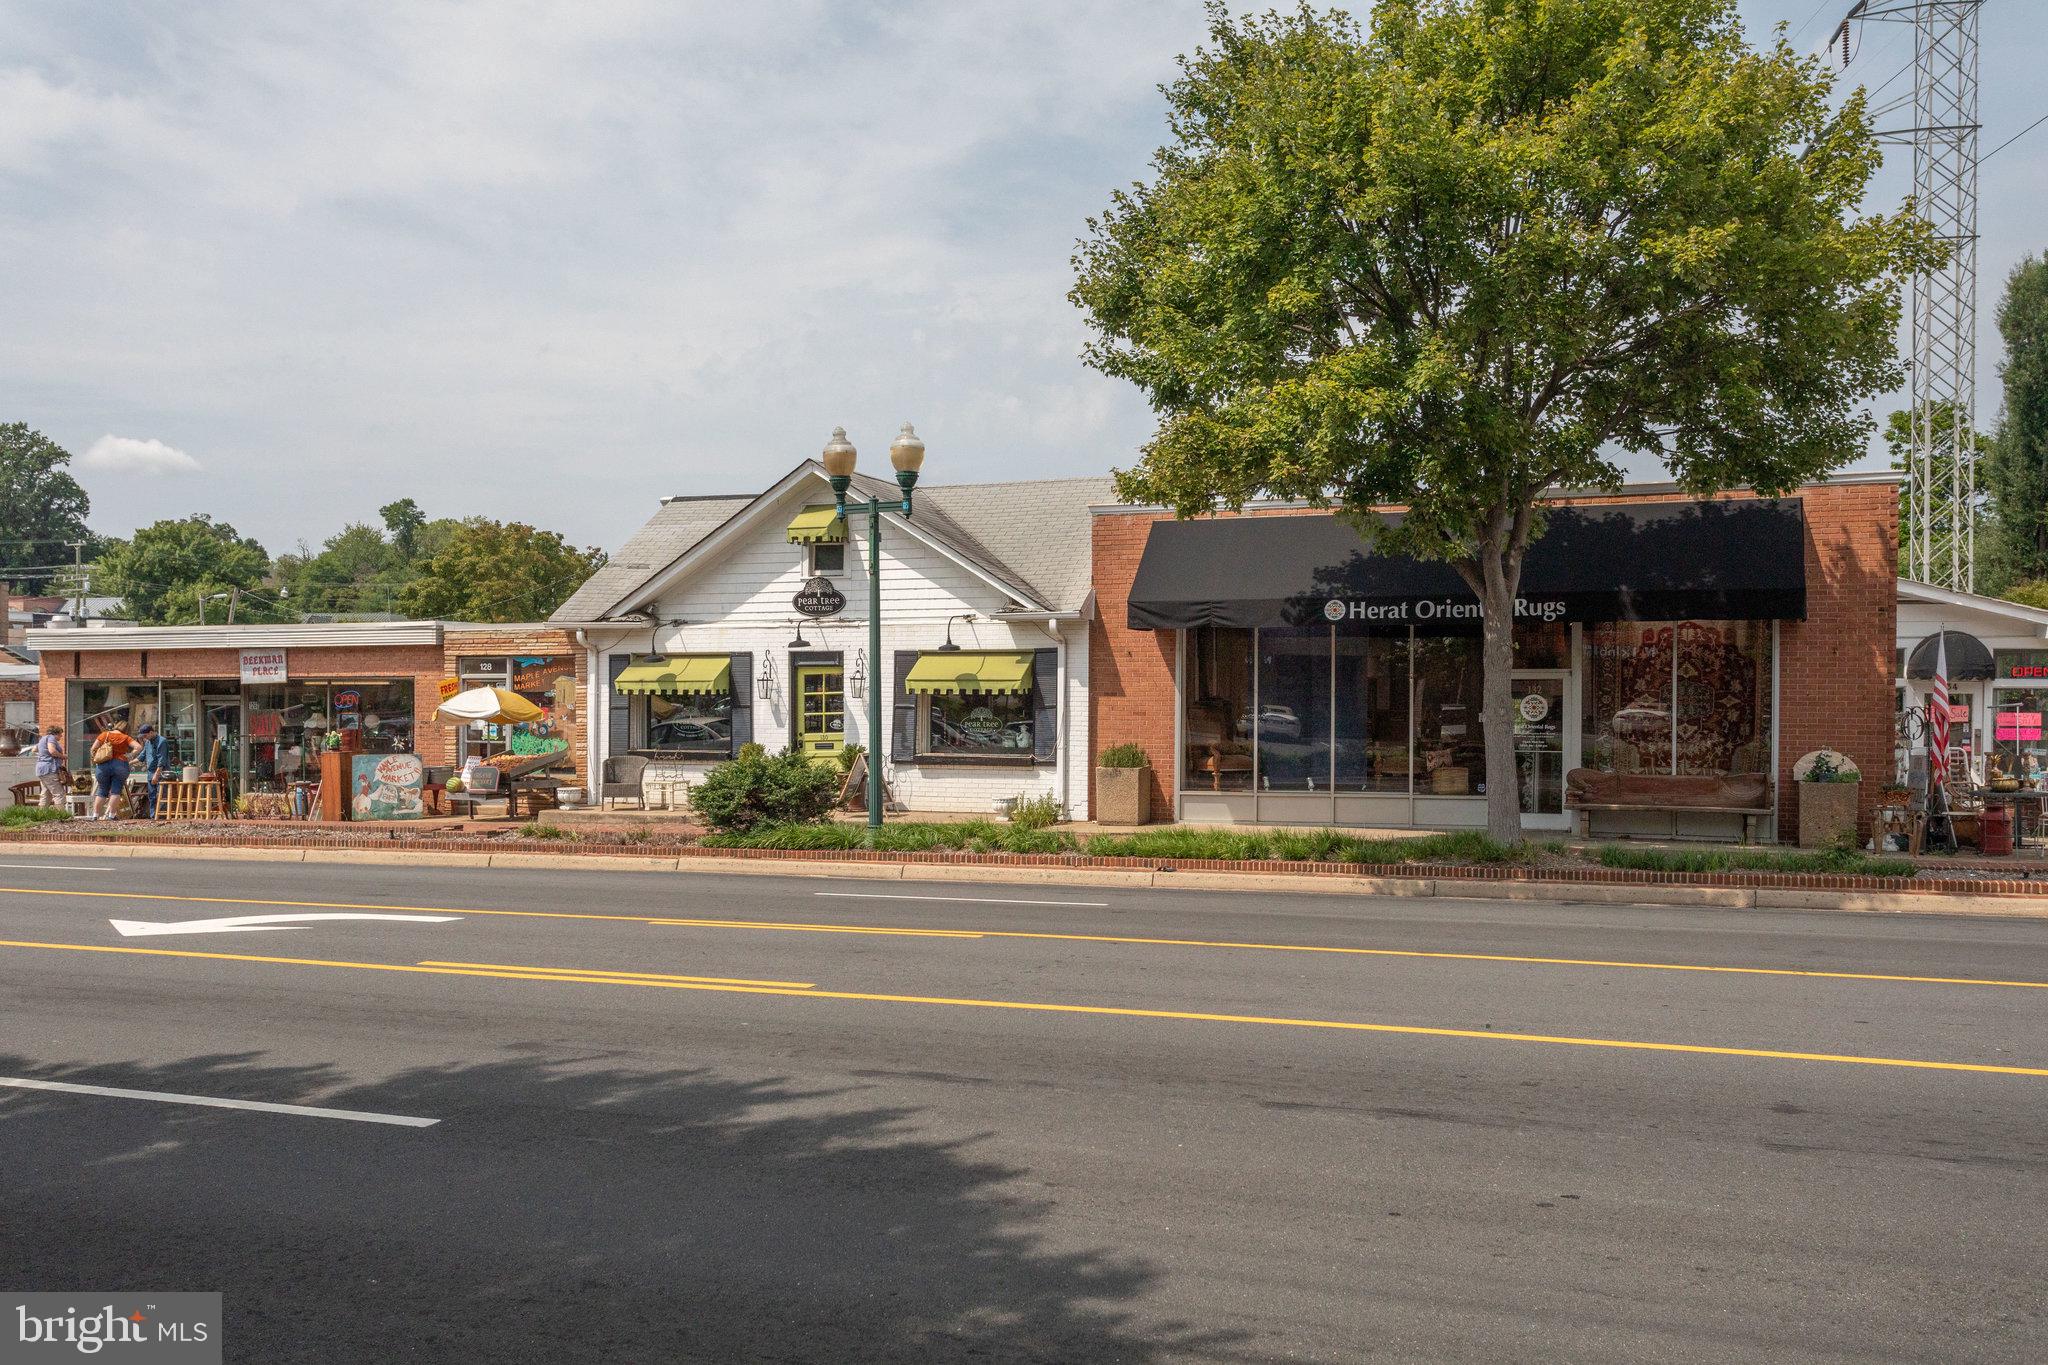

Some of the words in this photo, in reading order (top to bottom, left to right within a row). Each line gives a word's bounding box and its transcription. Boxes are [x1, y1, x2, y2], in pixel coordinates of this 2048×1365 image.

[1350, 601, 1408, 620] Herat
[1415, 599, 1485, 619] Orient
[1514, 597, 1566, 621] Rugs
[242, 655, 283, 665] BEEKMAN
[480, 662, 492, 671] 128
[513, 670, 540, 682] MAPLE
[542, 665, 575, 676] AVENU
[513, 678, 545, 690] MARKET
[334, 693, 360, 707] OPEN
